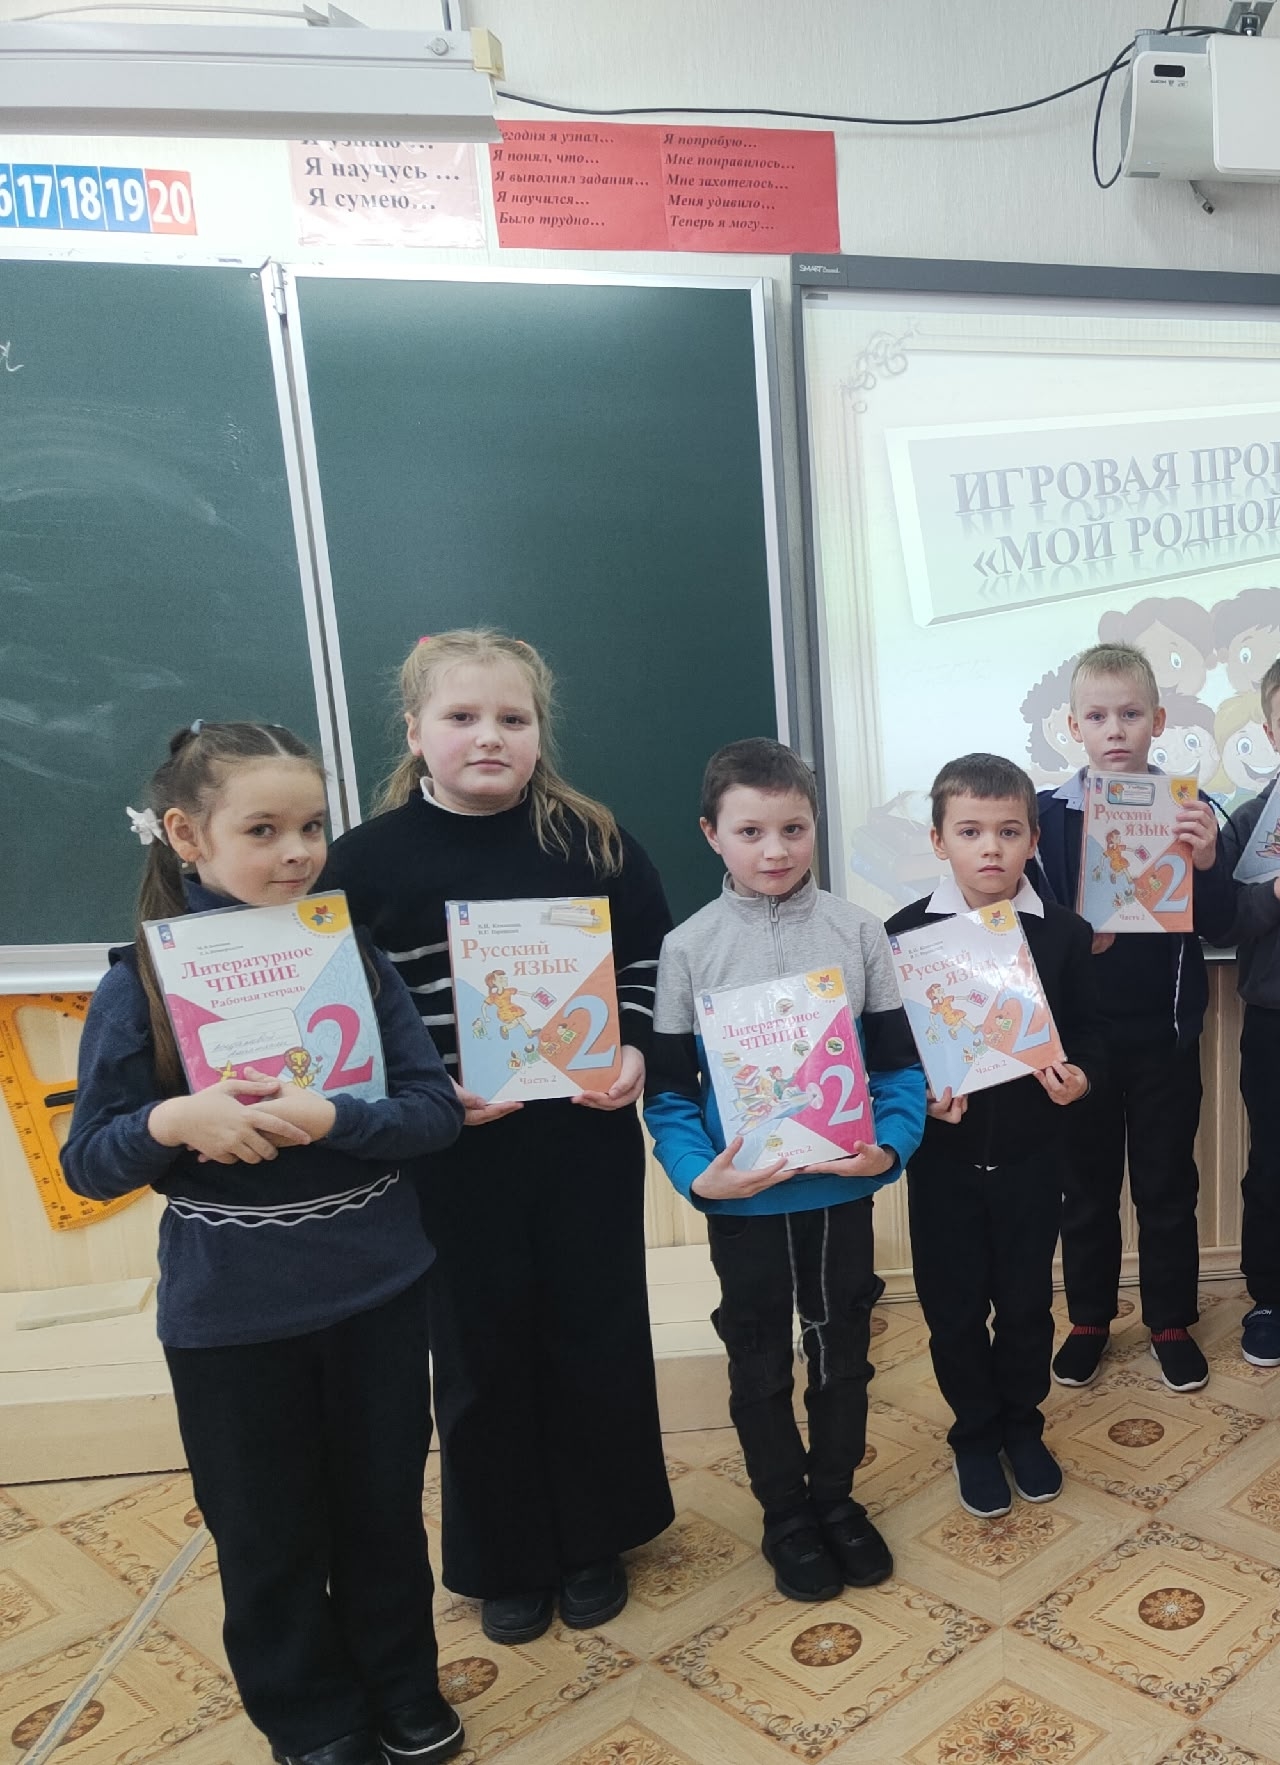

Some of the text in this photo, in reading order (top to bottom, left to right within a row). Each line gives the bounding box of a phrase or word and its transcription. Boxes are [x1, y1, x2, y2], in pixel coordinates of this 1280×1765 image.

[499, 129, 545, 142] егодня
[663, 133, 674, 144] Я
[492, 149, 503, 161] Я
[665, 153, 693, 165] Мне
[304, 156, 323, 176] Я
[331, 162, 427, 184] научусь
[495, 171, 505, 181] Я
[509, 174, 576, 185] выполнял
[666, 173, 695, 186] Мне
[17, 174, 53, 218] 17
[60, 176, 101, 221] 18
[105, 178, 146, 222] 19
[148, 179, 192, 225] 20
[309, 187, 327, 206] Я
[496, 191, 507, 202] Я
[668, 194, 704, 206] Меня
[499, 211, 534, 224] Было
[670, 215, 715, 230] Теперь
[717, 220, 725, 228] я
[799, 264, 823, 273] SMART
[949, 452, 1179, 515] ИГРОВАЯ
[973, 512, 1116, 578] «МОЙ
[1094, 804, 1152, 822] Русский
[1125, 824, 1170, 836] ЯЗЫК
[1153, 854, 1189, 912] 2
[461, 939, 550, 962] Русский
[181, 947, 313, 979] Литературное
[513, 958, 579, 976] ЯЗЫК
[205, 964, 300, 993] ЧТЕНИЕ
[211, 985, 306, 1009] Рабочая тетрадь
[723, 1009, 821, 1040] Литературное
[996, 987, 1051, 1054] 2
[563, 994, 618, 1071] 2
[739, 1025, 809, 1050] ЧТЕНИЕ
[307, 1004, 374, 1091] 2
[519, 1075, 557, 1085] Часть 2
[820, 1065, 864, 1126] 2
